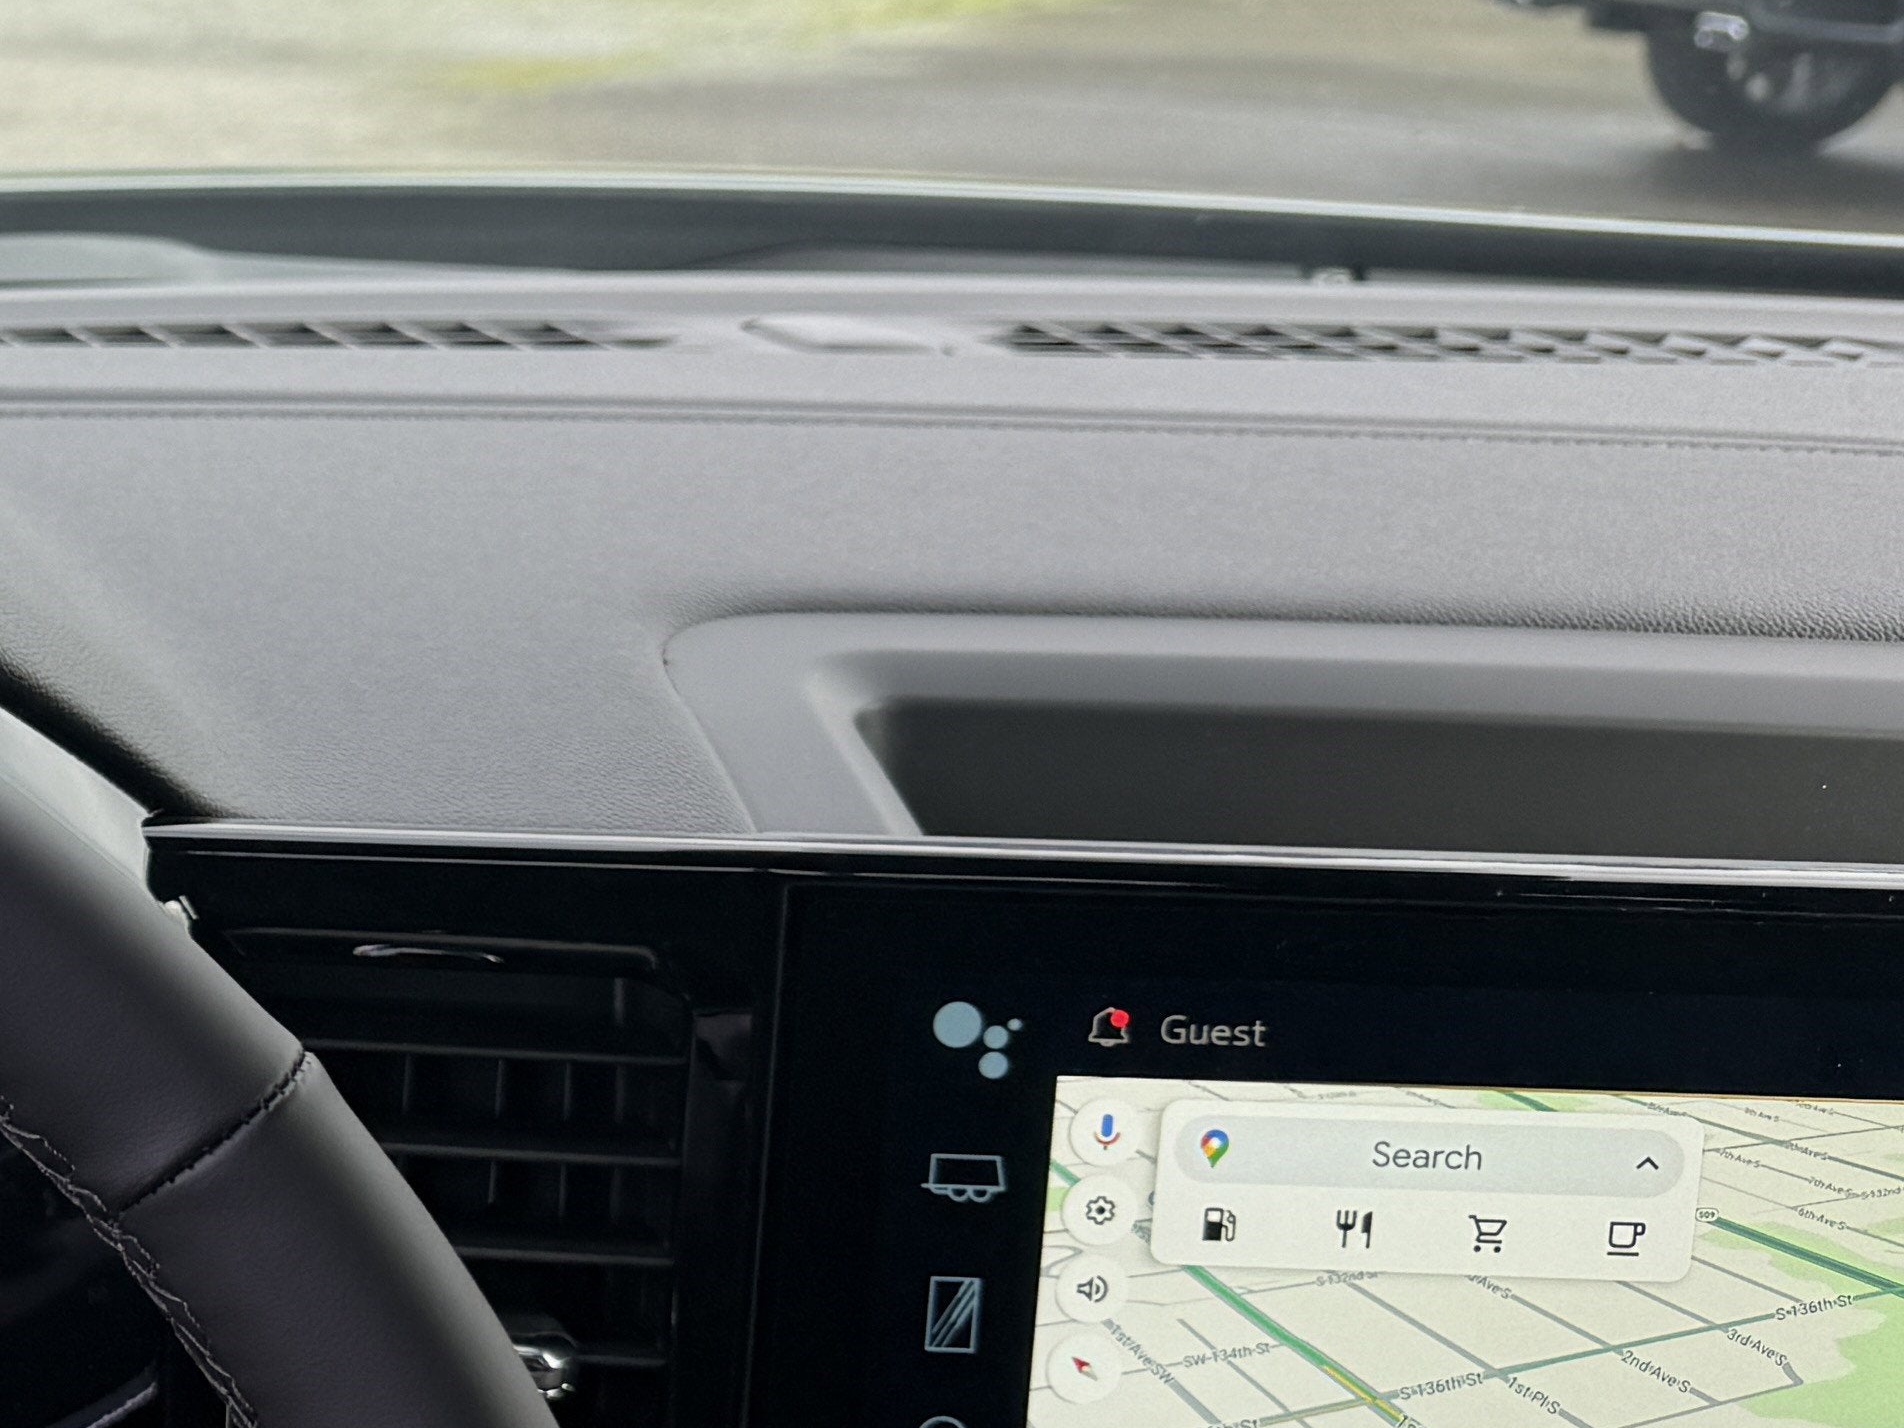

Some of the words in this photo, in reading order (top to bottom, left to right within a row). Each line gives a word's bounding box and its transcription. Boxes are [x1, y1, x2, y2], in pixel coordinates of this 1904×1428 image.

[1160, 1015, 1267, 1047] Guest
[1372, 1141, 1482, 1171] Search
[1798, 1208, 1815, 1220] 6th
[1816, 1214, 1837, 1227] Ave
[1477, 1275, 1503, 1298] Ave
[1502, 1288, 1512, 1300] S
[1776, 1307, 1787, 1320] S
[1791, 1298, 1833, 1317] 136th
[1837, 1294, 1853, 1308] St
[1111, 1325, 1132, 1347] 1st
[1128, 1344, 1152, 1366] Ave
[1150, 1363, 1175, 1384] SW
[1183, 1354, 1207, 1368] SW
[1212, 1347, 1252, 1362] 134th
[1255, 1343, 1270, 1355] St
[1727, 1328, 1750, 1347] 3rd
[1753, 1340, 1777, 1360] Ave
[1776, 1353, 1788, 1366] S
[1400, 1387, 1411, 1401] S
[1417, 1376, 1462, 1397] 136th
[1466, 1373, 1483, 1387] St
[1621, 1350, 1651, 1373] 2nd
[1650, 1366, 1678, 1387] Ave
[1679, 1380, 1692, 1394] S
[1508, 1376, 1531, 1398] 1st
[1531, 1391, 1550, 1408] Pl
[1547, 1401, 1560, 1415] S
